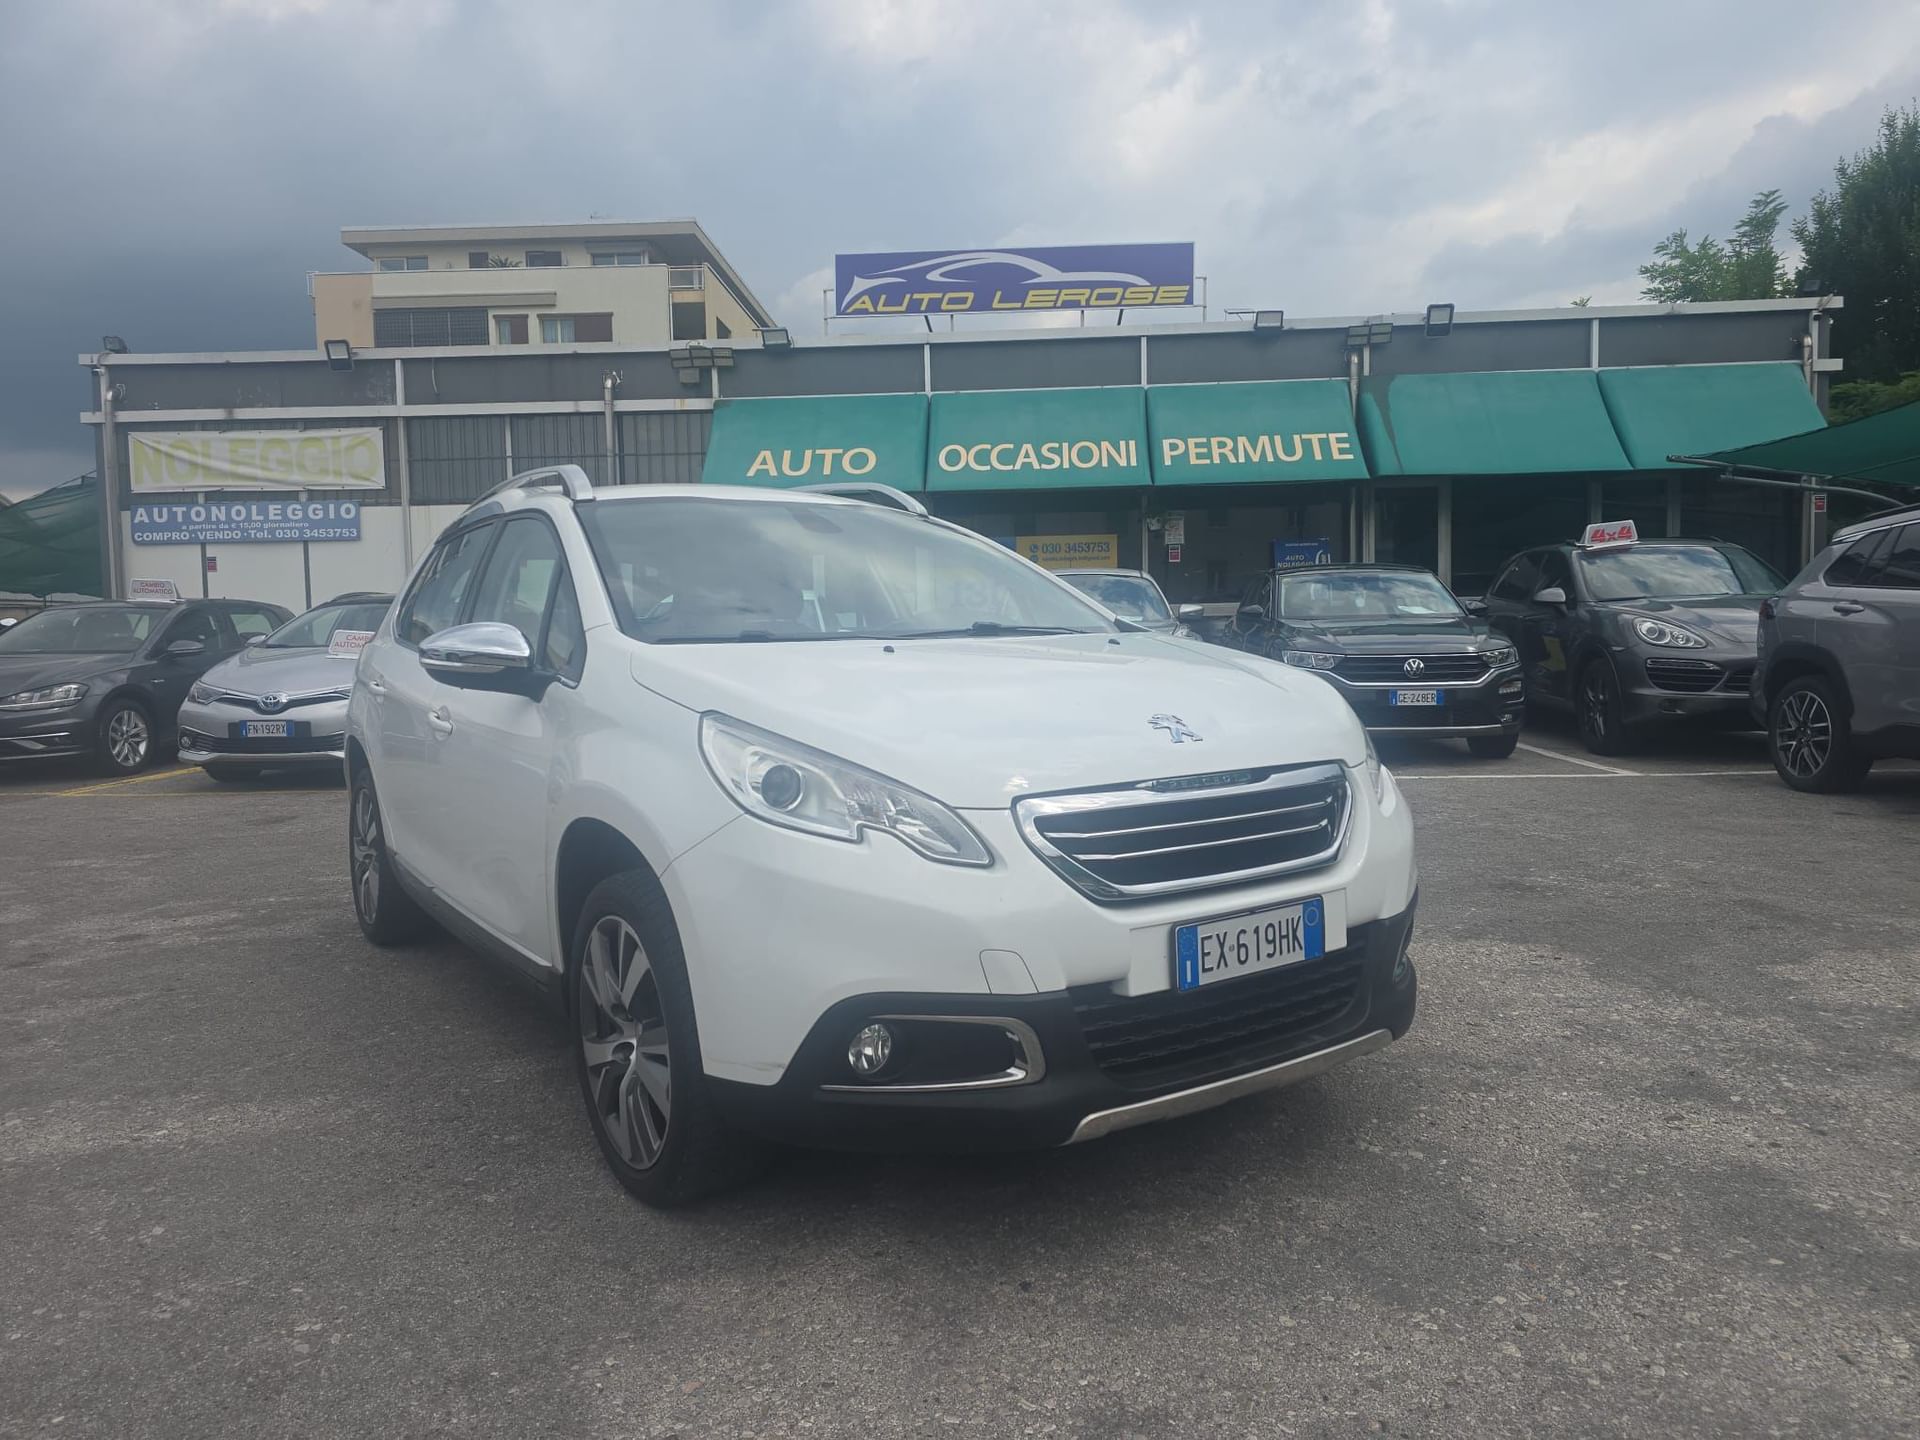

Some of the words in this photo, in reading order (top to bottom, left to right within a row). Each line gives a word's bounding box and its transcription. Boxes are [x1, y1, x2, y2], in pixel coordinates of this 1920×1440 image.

[846, 291, 975, 314] AUTO
[991, 285, 1190, 309] LEROSE
[133, 437, 377, 483] NOLEGGIO
[746, 447, 877, 477] AUTO
[938, 439, 1137, 472] OCCASIONI
[1162, 432, 1354, 465] PERMUTE
[133, 503, 356, 523] AUTONOLEGGIO
[134, 531, 190, 541] COMPRO
[197, 530, 242, 540] VENDO
[248, 530, 272, 539] Tel.
[275, 529, 300, 538] 030
[303, 528, 358, 538] 3453753
[1041, 543, 1061, 554] 030
[1065, 541, 1110, 553] 3453753
